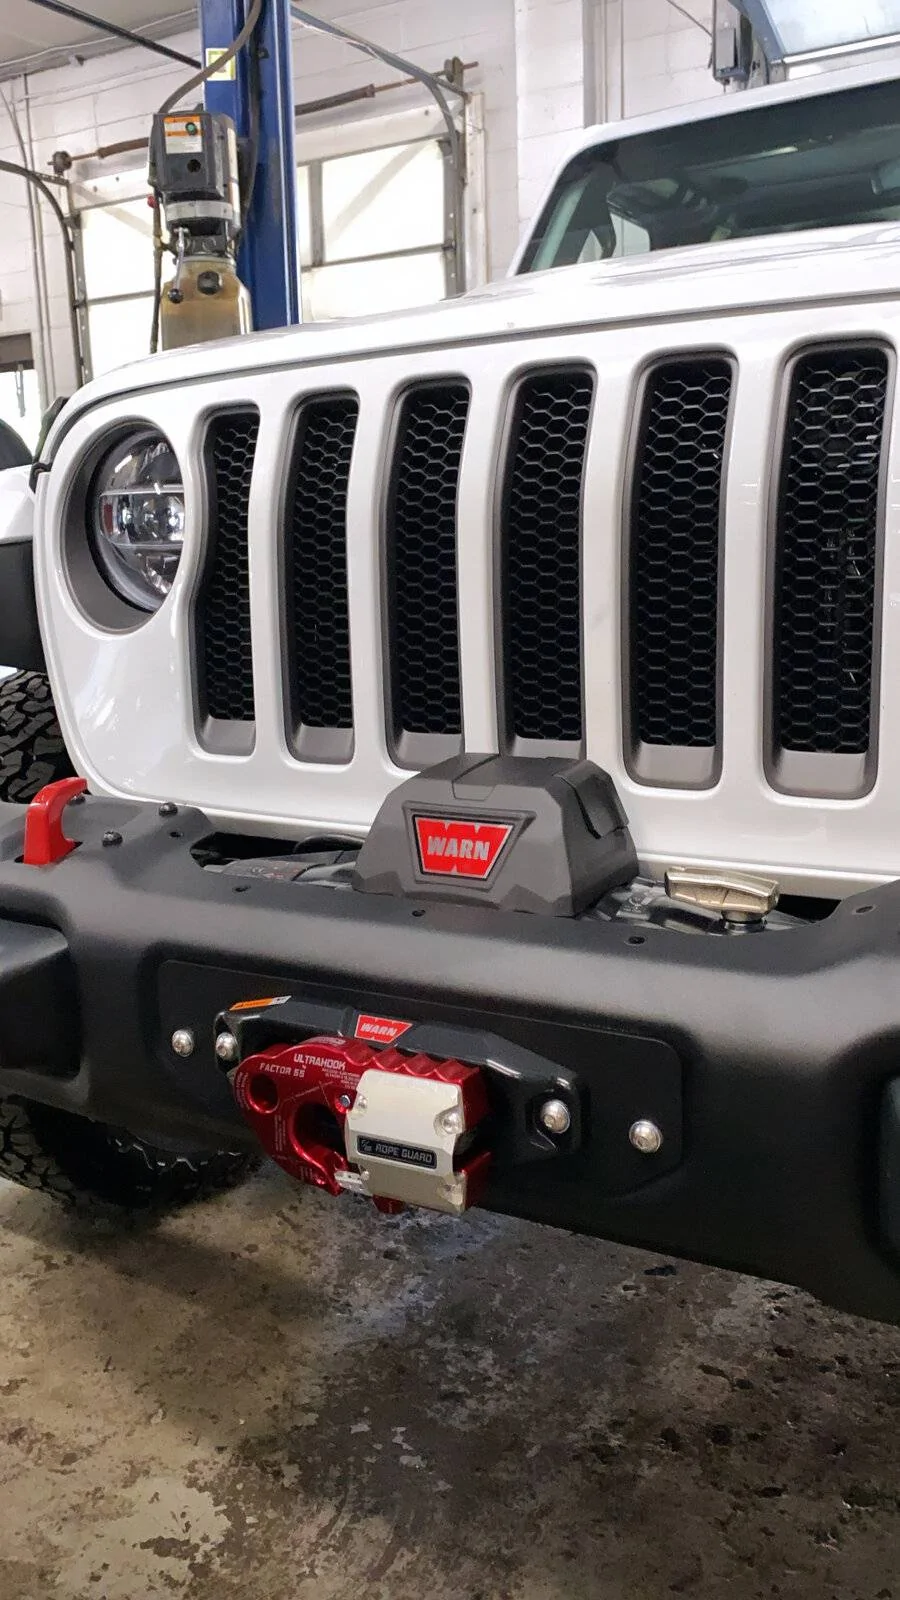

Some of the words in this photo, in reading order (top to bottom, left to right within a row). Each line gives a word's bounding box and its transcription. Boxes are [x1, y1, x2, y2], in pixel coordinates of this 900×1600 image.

[427, 835, 491, 861] WARN
[360, 1023, 398, 1037] WARN
[259, 1062, 292, 1076] FACTOR
[293, 1053, 346, 1071] ULTRAHOOK
[375, 1143, 400, 1156] ROPE
[401, 1148, 433, 1163] GUARD
